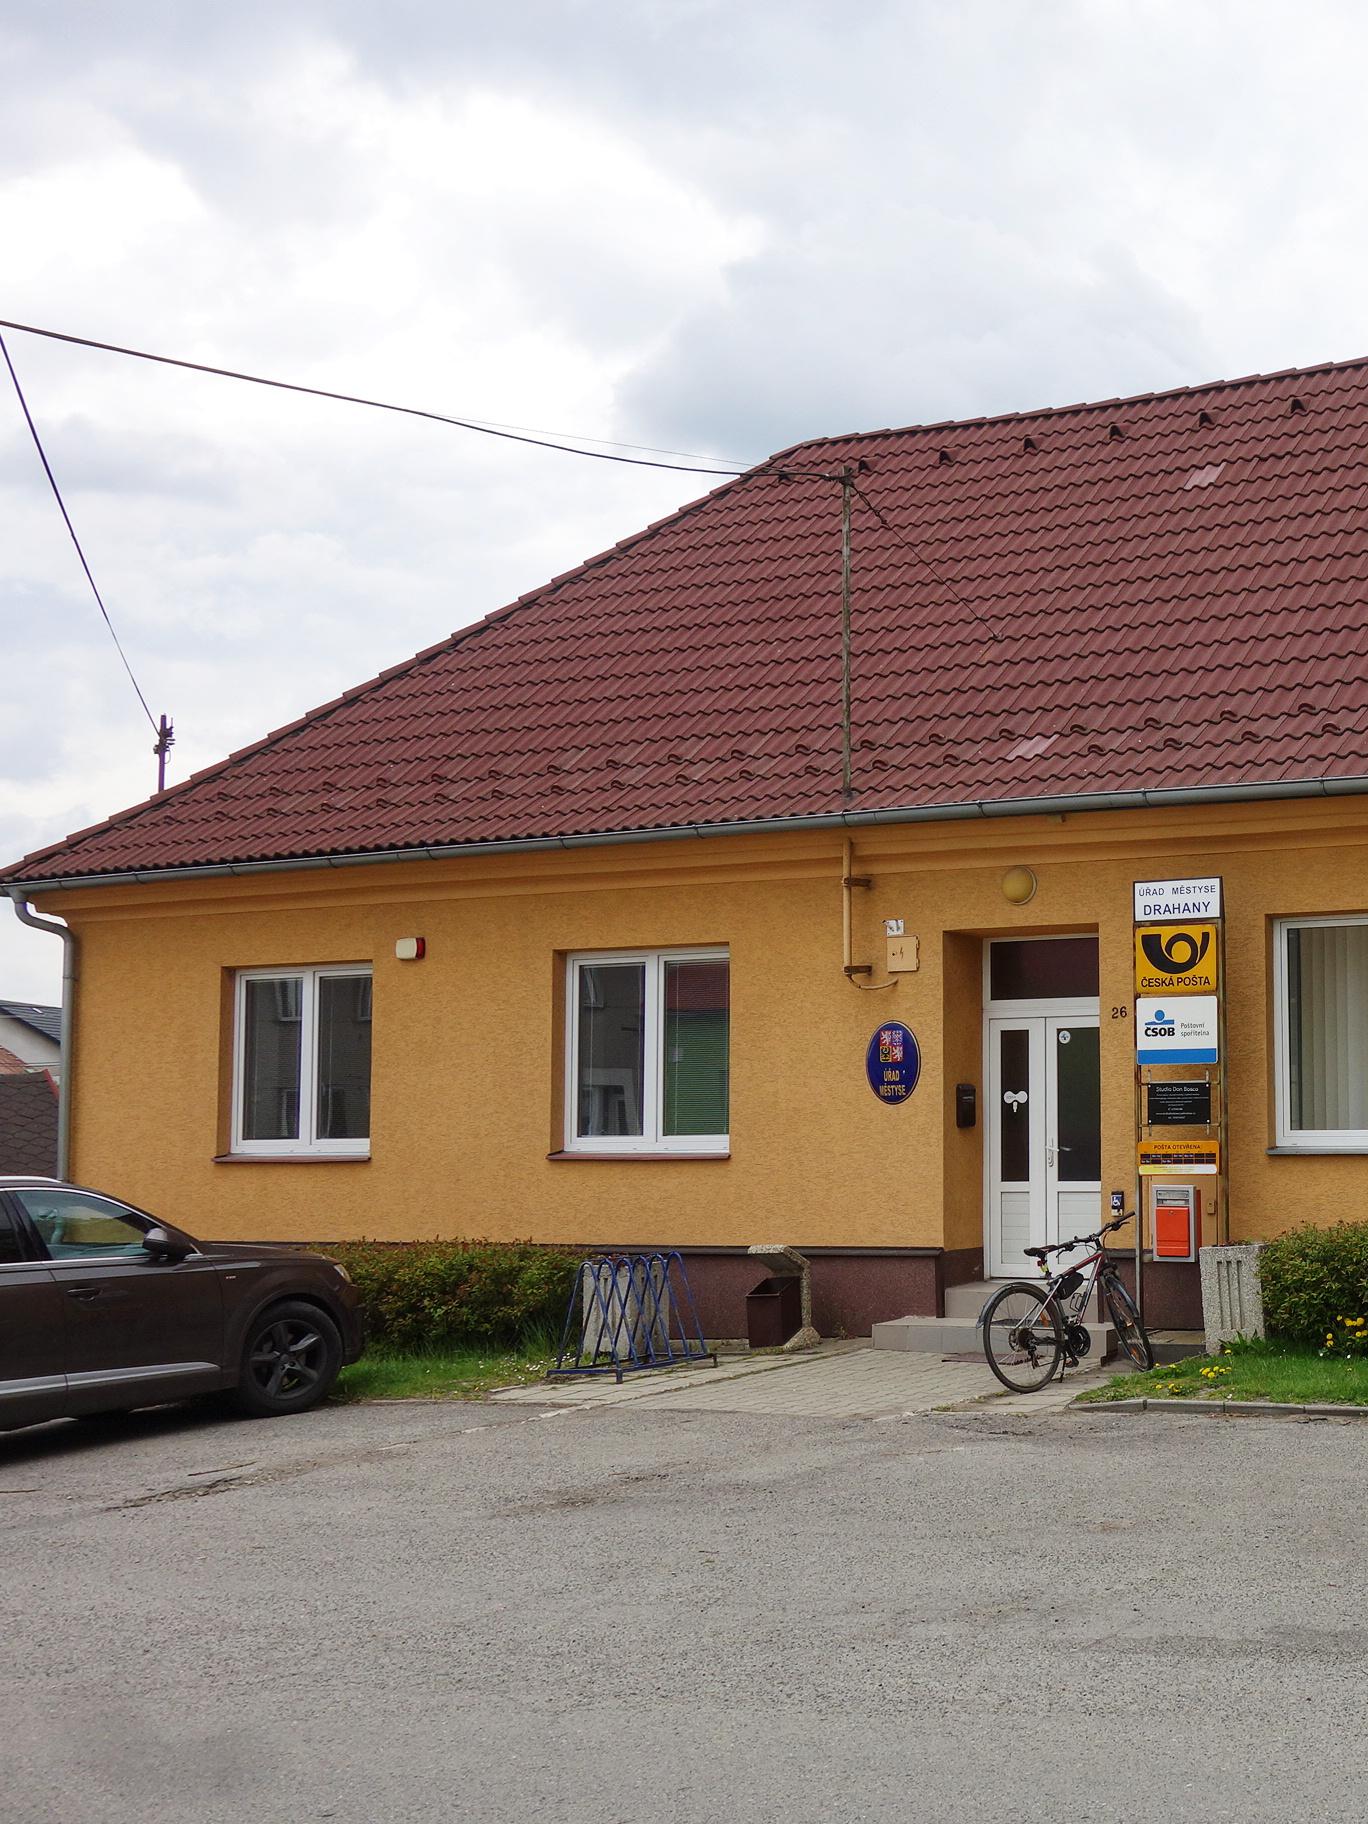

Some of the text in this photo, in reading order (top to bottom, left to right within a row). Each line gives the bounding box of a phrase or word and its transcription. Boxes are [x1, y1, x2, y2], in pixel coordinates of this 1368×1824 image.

[1138, 884, 1216, 897] ÚŘAD MĚSTYSE
[1143, 901, 1211, 916] DRAHANY
[1140, 974, 1211, 988] ČESKÁ POŠTA
[1111, 1006, 1128, 1019] 26
[1144, 1026, 1176, 1037] ČSOB
